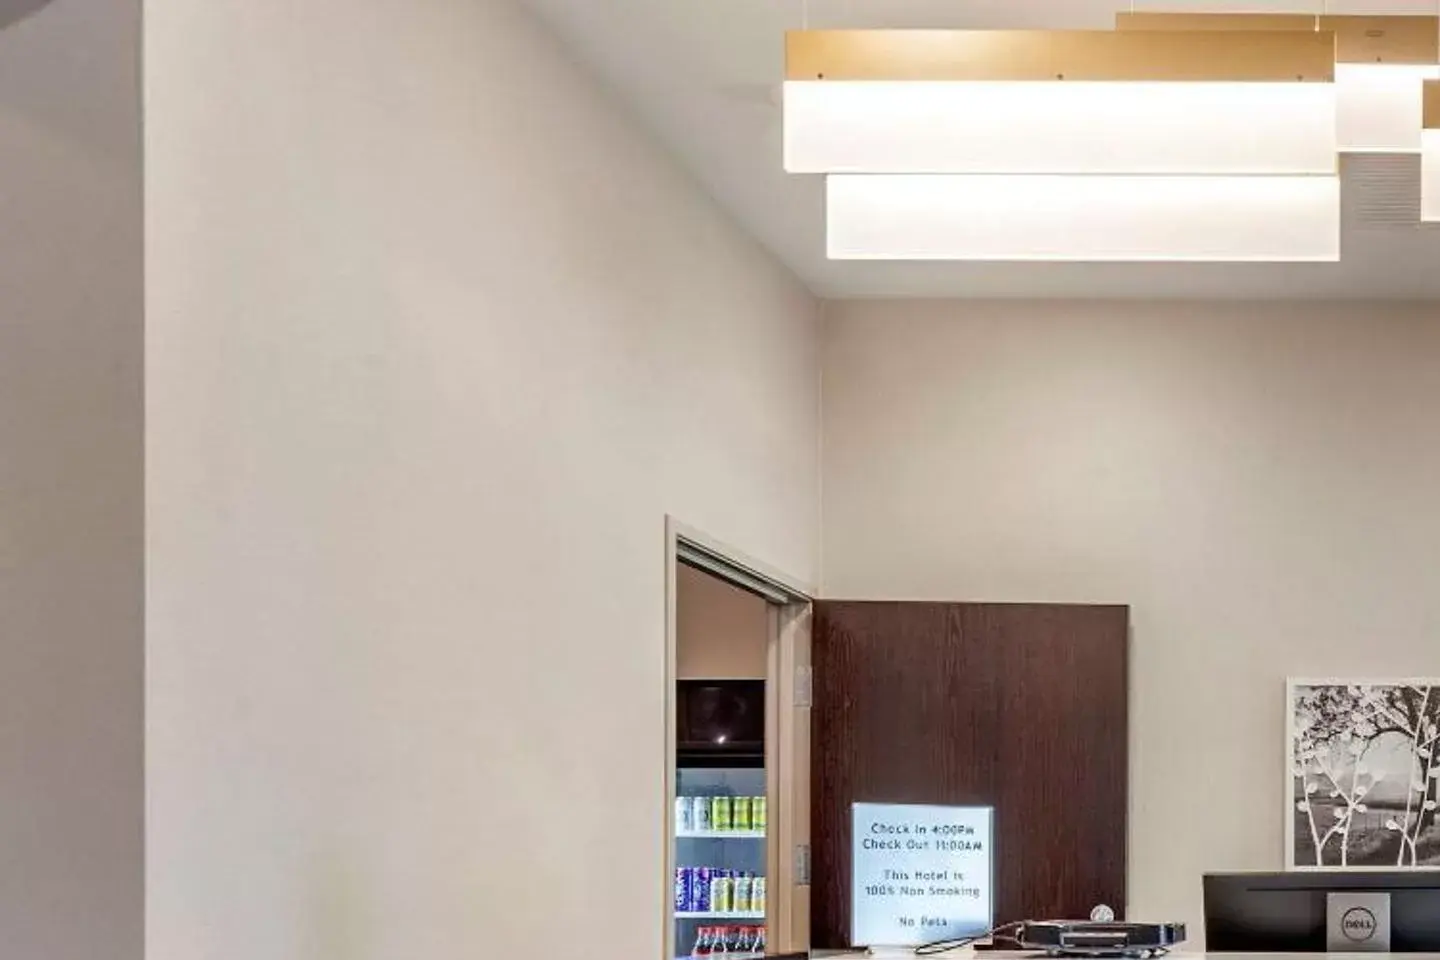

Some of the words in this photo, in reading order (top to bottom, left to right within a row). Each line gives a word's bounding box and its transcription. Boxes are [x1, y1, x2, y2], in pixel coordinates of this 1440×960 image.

[862, 838, 902, 850] Check
[905, 839, 930, 850] Out
[884, 869, 909, 880] This
[914, 870, 948, 880] Hotel
[899, 886, 925, 897] Non
[928, 886, 980, 899] Smoking
[898, 916, 915, 928] No
